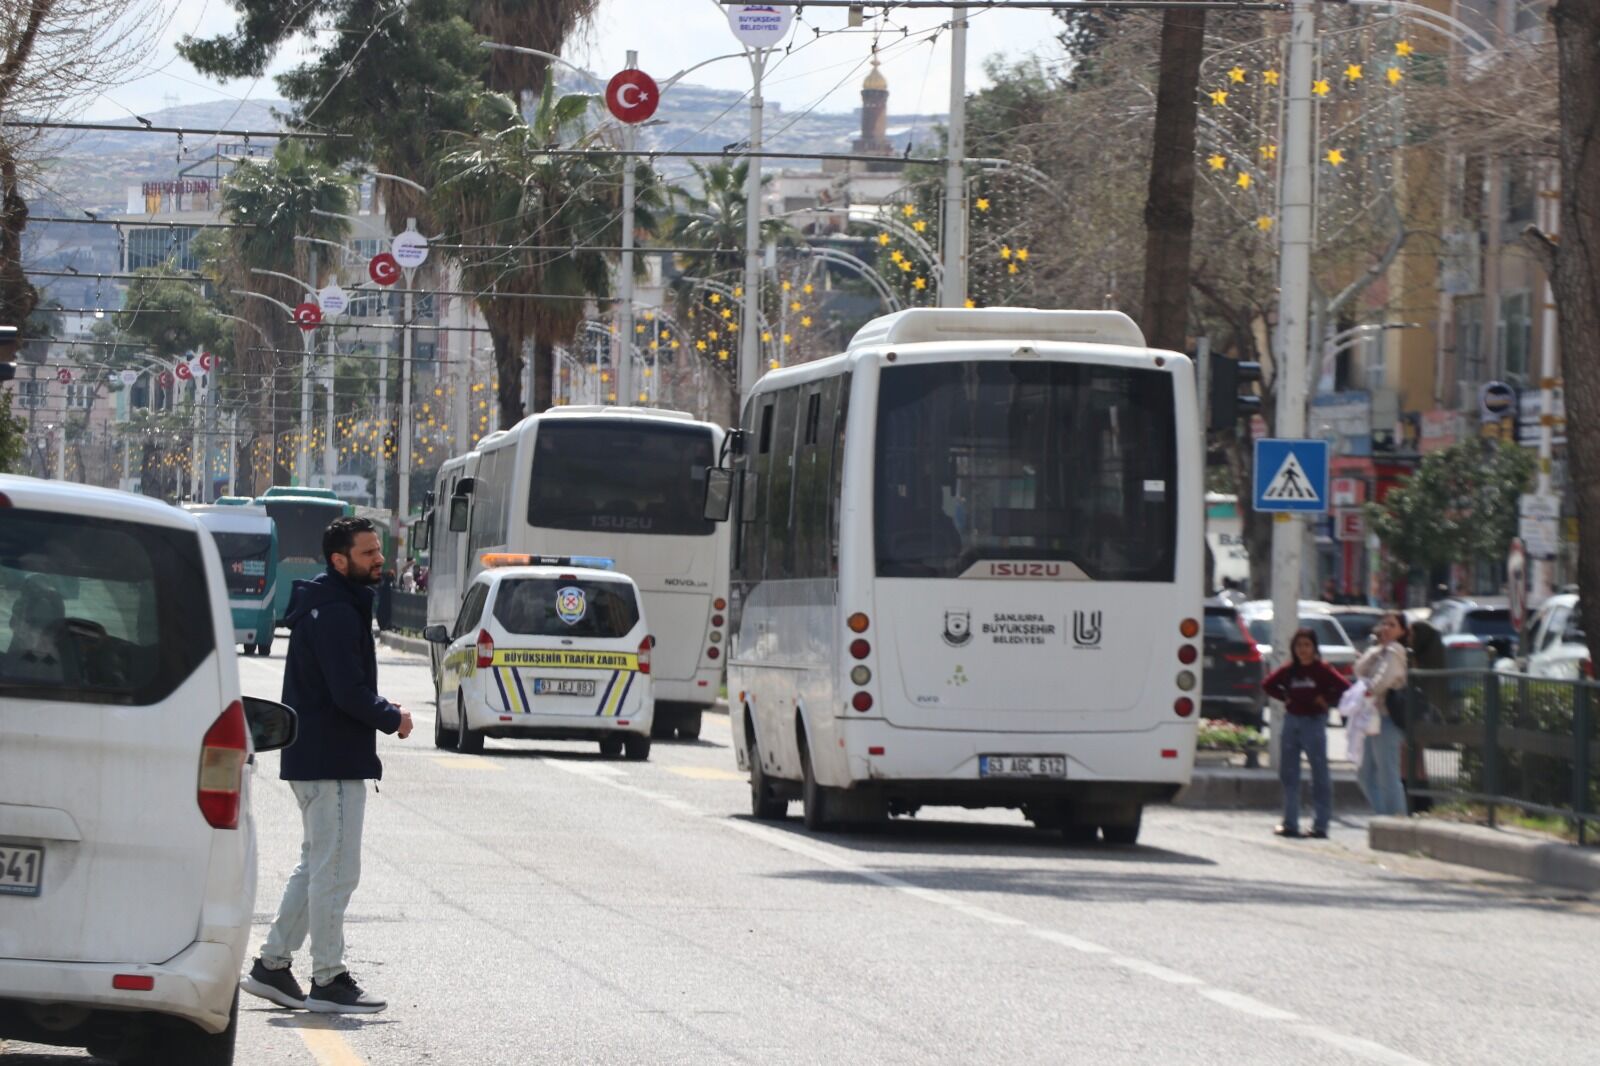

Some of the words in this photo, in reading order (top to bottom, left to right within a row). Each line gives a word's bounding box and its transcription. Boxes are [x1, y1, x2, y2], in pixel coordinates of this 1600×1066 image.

[591, 515, 653, 529] ISUZU
[990, 563, 1060, 577] ISUZU
[504, 650, 562, 664] BÜYÜKŞEHİR
[564, 651, 595, 665] TRAFİK
